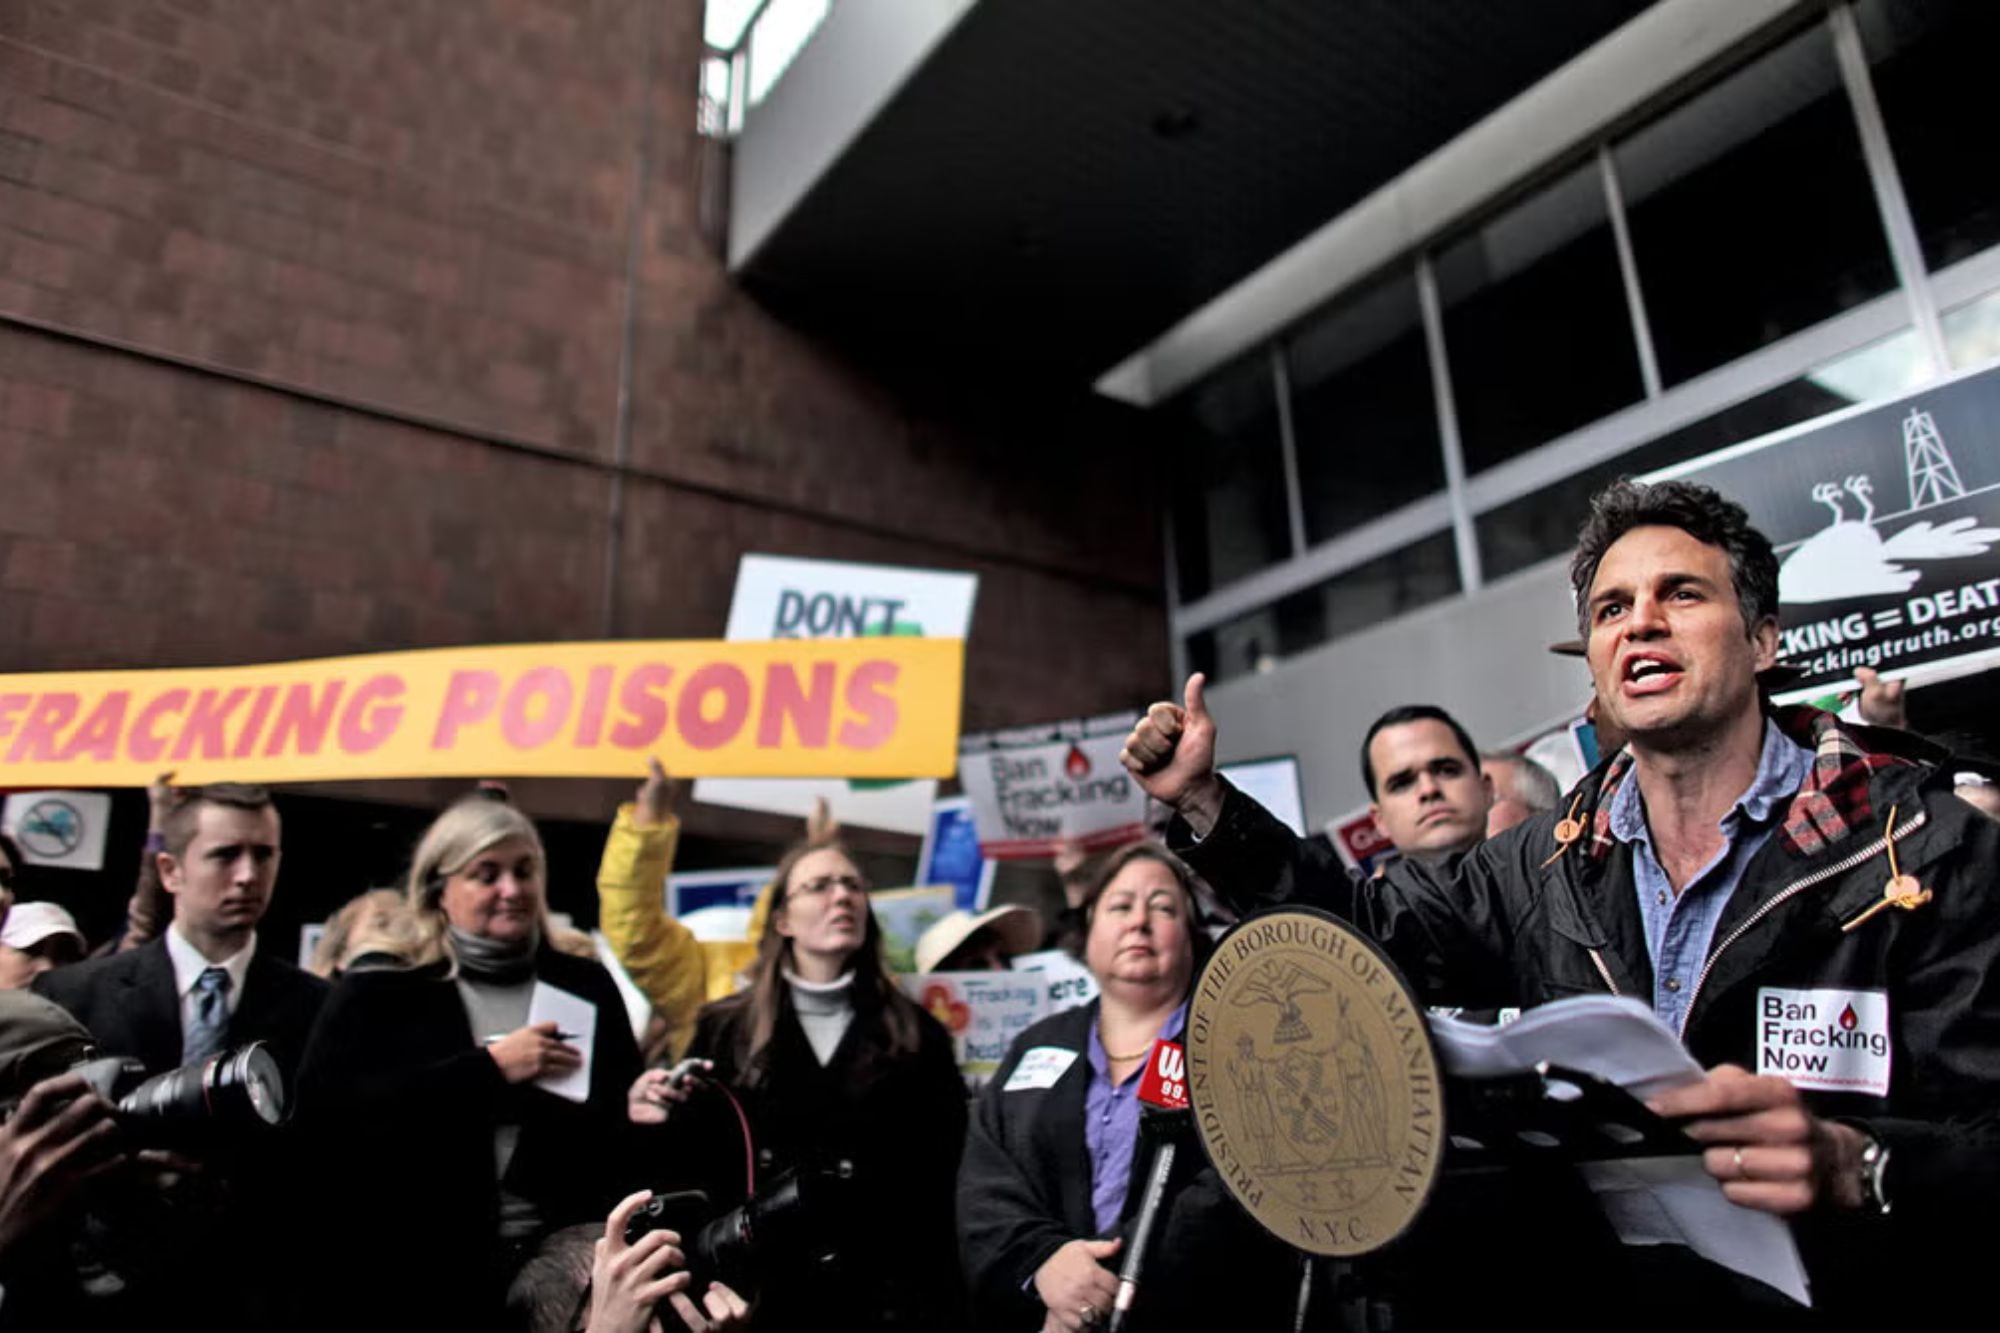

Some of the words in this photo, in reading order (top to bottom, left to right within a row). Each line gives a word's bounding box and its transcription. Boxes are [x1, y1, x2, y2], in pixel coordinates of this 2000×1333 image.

[1907, 577, 2000, 626] DEAT
[430, 659, 902, 751] POISONS
[991, 757, 1047, 782] Ban
[997, 776, 1130, 812] Fracking
[1233, 921, 1347, 960] BOROUGH
[1203, 953, 1235, 1001] THE
[1351, 953, 1386, 987] OF
[1764, 996, 1816, 1020] Ban
[1193, 1011, 1210, 1044] OF
[1763, 1022, 1887, 1057] Fracking
[1763, 1047, 1828, 1073] Now
[1381, 991, 1431, 1207] MANHATTAN
[1193, 1053, 1264, 1208] PRESIDENT
[1299, 1216, 1370, 1245] N.Y.C.
